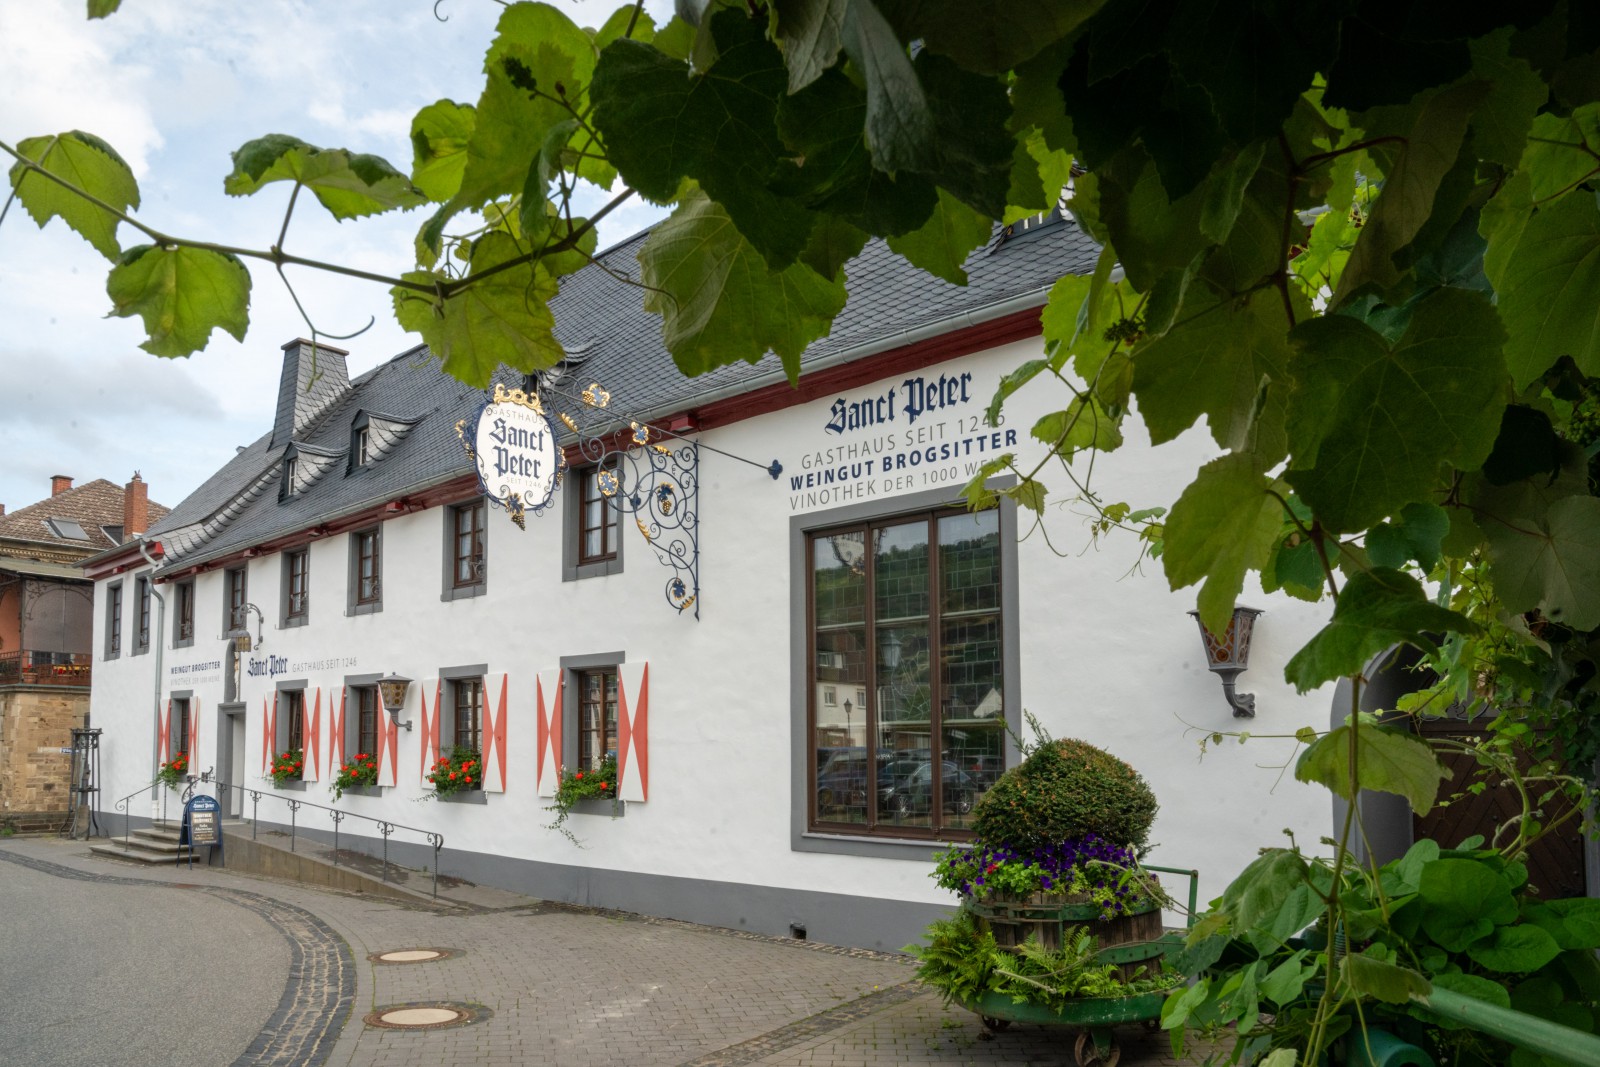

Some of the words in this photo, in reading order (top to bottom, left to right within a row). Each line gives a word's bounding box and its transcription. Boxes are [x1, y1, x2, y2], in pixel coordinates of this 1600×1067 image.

[491, 406, 544, 425] GASTHAUS
[824, 385, 896, 436] Sanct
[900, 371, 972, 425] Peter
[489, 417, 544, 452] Sanct
[801, 434, 896, 470] GASTHAUS
[905, 422, 947, 447] SEIT
[491, 445, 542, 479] Peter
[790, 460, 875, 491] WEINGUT
[882, 429, 1017, 473] BROGSITTER
[790, 479, 876, 511] VINOTHEK
[884, 474, 914, 493] DER
[922, 466, 958, 485] 1000
[171, 664, 191, 675] WEINGUT
[191, 660, 221, 673] BROGSITTER
[248, 657, 268, 677] Sanct
[269, 655, 288, 679] Peter
[292, 660, 325, 673] GASTHAUS
[326, 658, 340, 669] SEIT
[342, 656, 357, 668] 1246
